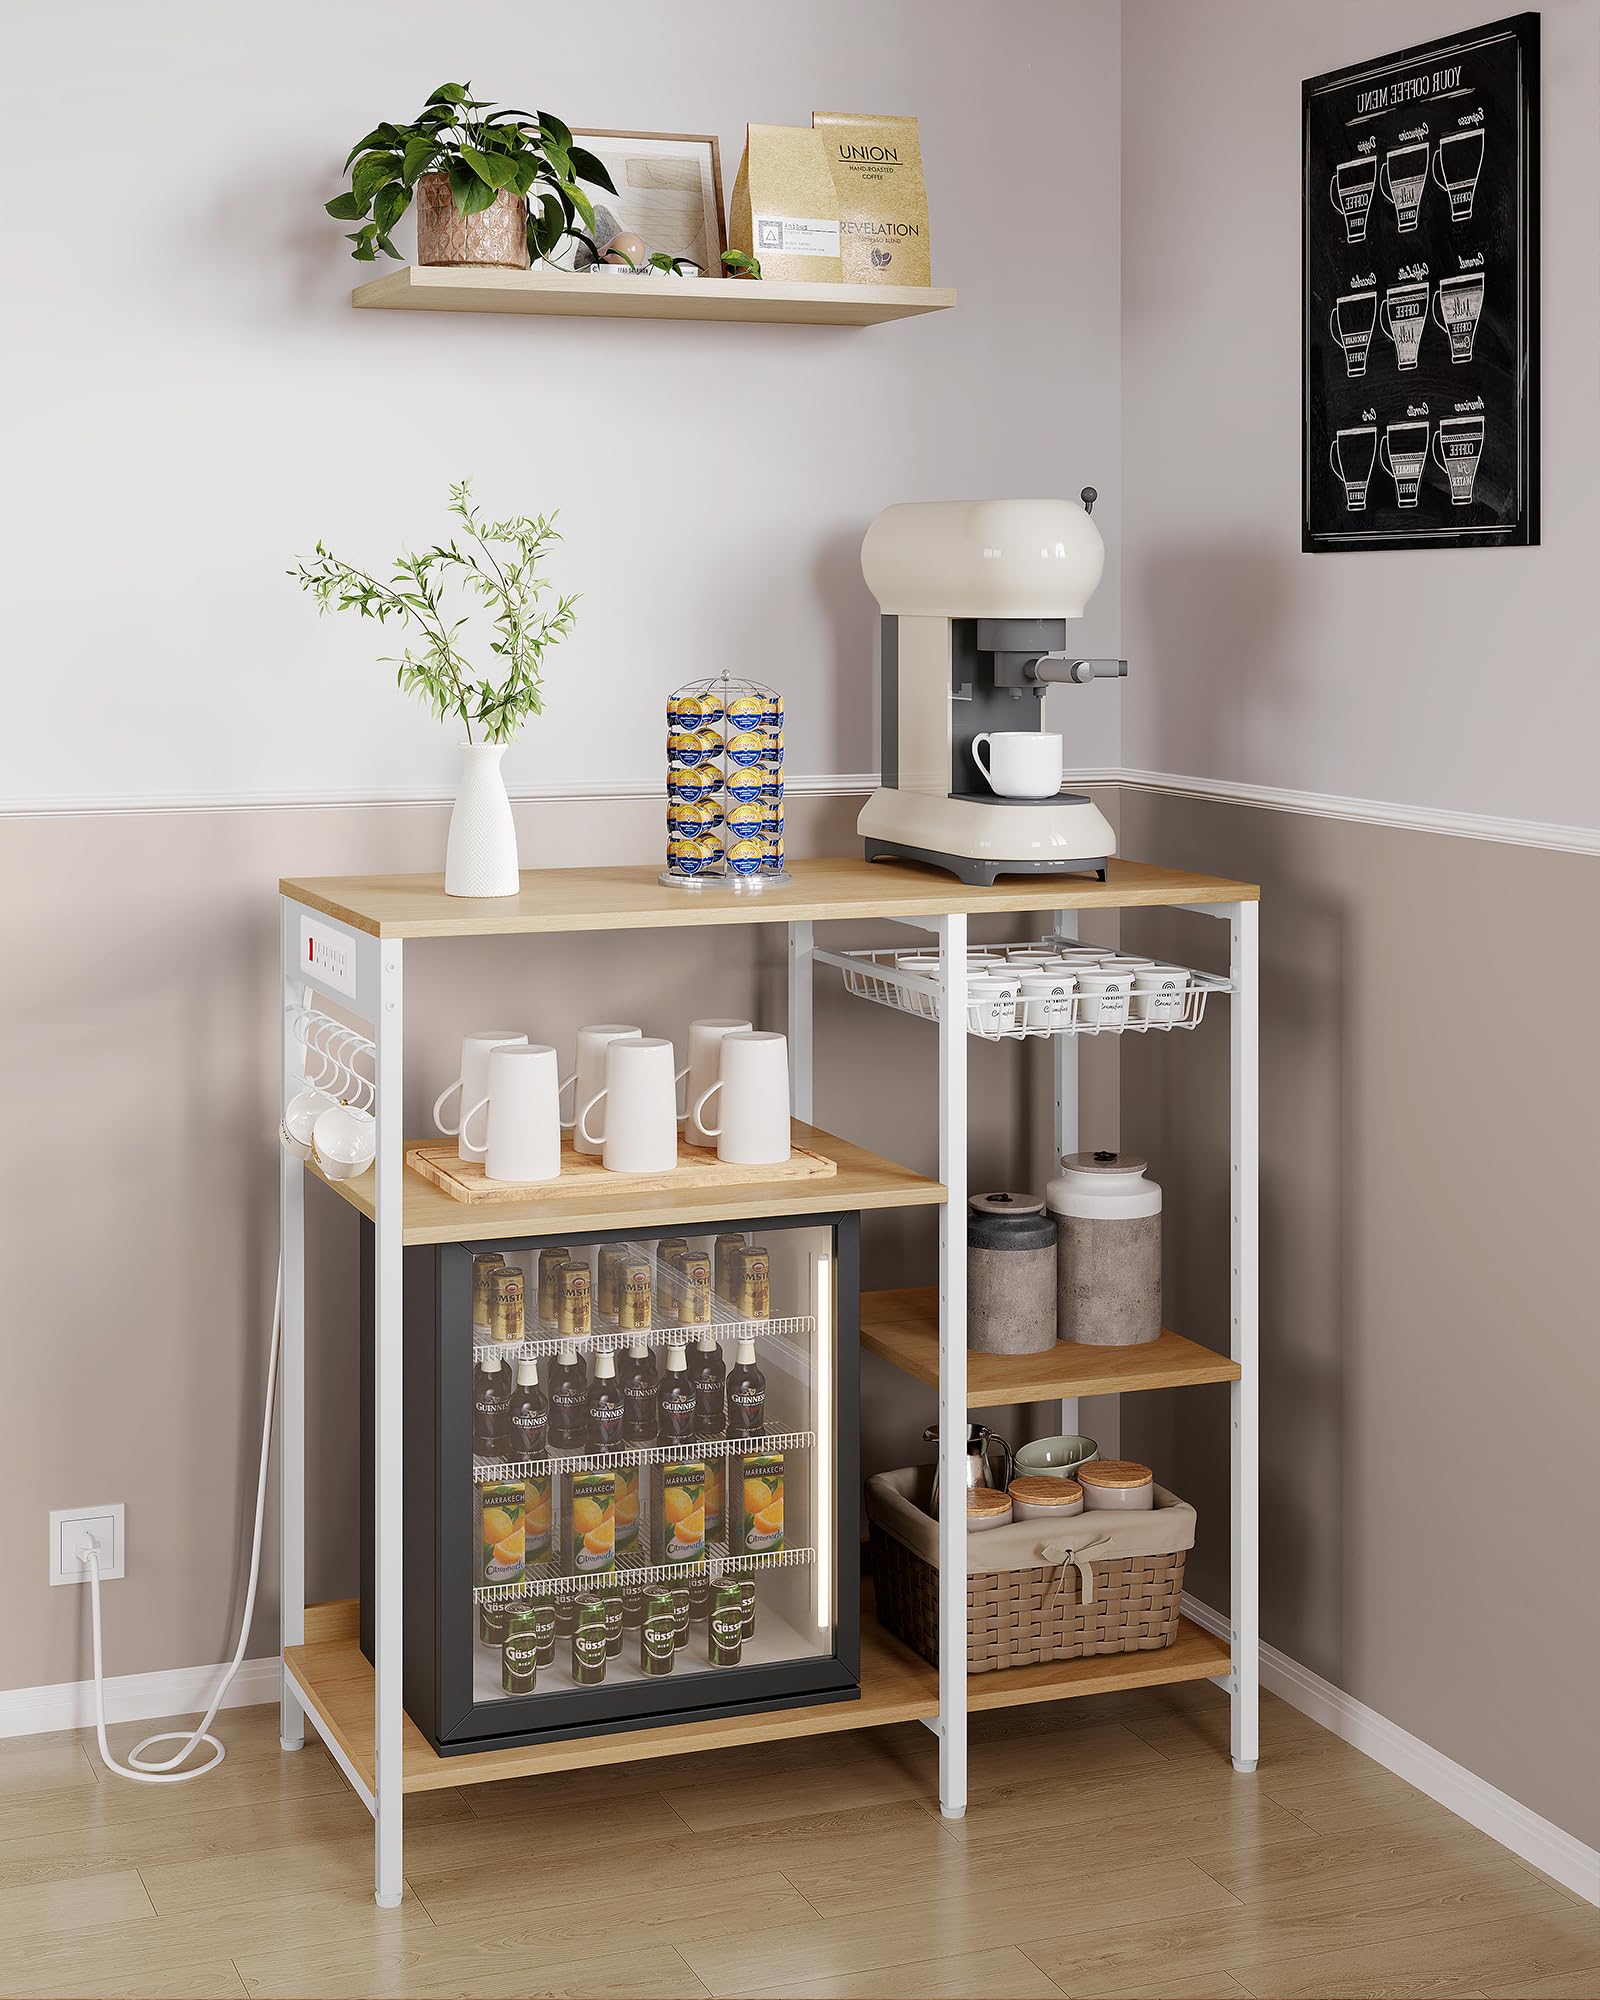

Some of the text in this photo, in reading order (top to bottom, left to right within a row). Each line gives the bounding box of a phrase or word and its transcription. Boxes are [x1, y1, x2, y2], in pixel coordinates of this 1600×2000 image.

[840, 145, 898, 161] UNION
[840, 222, 919, 236] REVELATION
[745, 1465, 784, 1476] MARRAKECH
[666, 1474, 705, 1485] MARRAKECH
[575, 1484, 615, 1495] MARRAKECH
[484, 1494, 525, 1505] MARRAKECH
